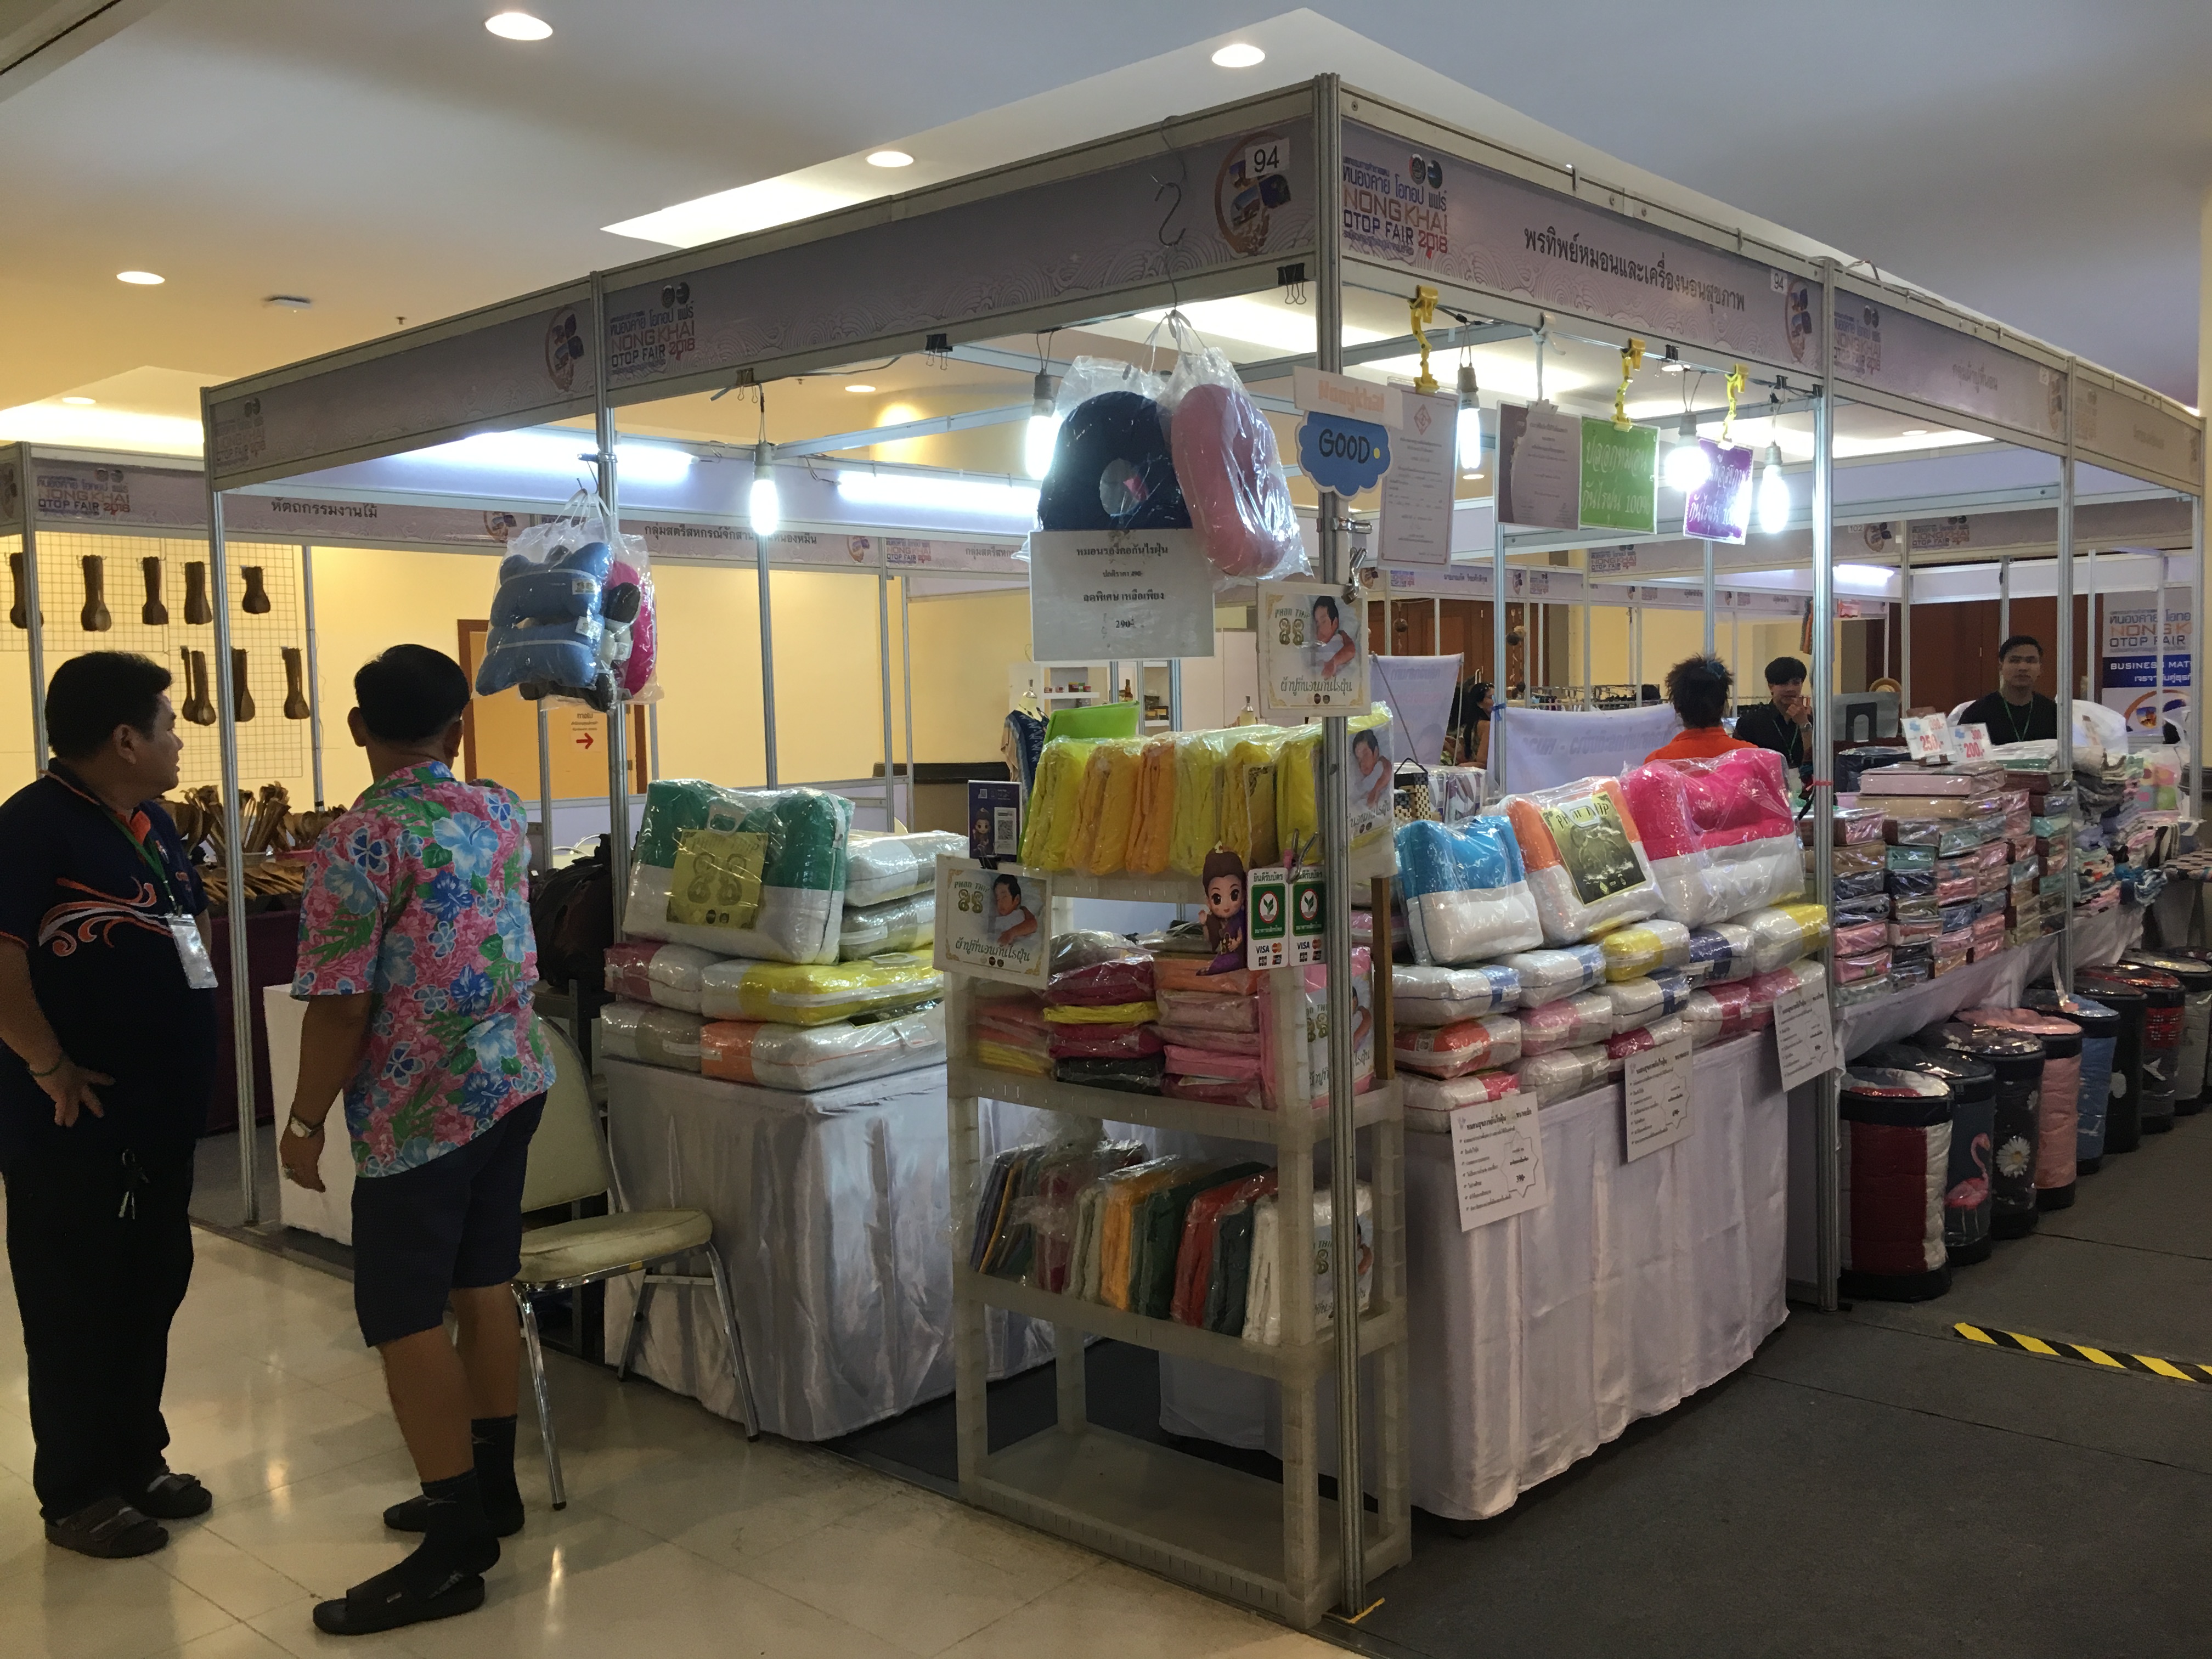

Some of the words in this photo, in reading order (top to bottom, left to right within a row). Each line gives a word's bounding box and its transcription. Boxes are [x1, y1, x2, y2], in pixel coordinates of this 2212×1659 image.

[1254, 145, 1279, 173] 94
[1343, 166, 1390, 194] หนองคาย
[1395, 173, 1424, 205] โอทอป
[1344, 187, 1401, 222] NONG
[1405, 203, 1447, 234] KHAI
[1344, 209, 1380, 234] OTOP
[1386, 221, 1414, 245] FAIR
[1418, 230, 1447, 253] 2018
[1525, 225, 1745, 314] พรทิพย์หมอนและเครื่องนอนสุขภาพ
[1774, 274, 1784, 290] 94
[612, 330, 655, 353] NONG
[659, 320, 695, 342] KHAI
[612, 350, 639, 368] OTOP
[642, 344, 665, 361] FAIR
[668, 338, 695, 355] 2018
[1319, 428, 1370, 464] GOOD
[38, 488, 88, 500] NONG
[91, 491, 129, 504] KHAI
[38, 499, 70, 508] OTOP
[74, 501, 99, 510] FAIR
[103, 503, 130, 512] 2018
[272, 497, 377, 518] หัตถกรรมงานไม้
[1625, 495, 1650, 514] 100%
[2109, 637, 2147, 647] OTOP
[2111, 662, 2164, 670] BUSINES
[1254, 872, 1283, 882] ยินดีรับบัตร
[956, 938, 1030, 964] ผ้าปูที่นอนกันไรฝุ่น
[1297, 941, 1310, 950] VISA
